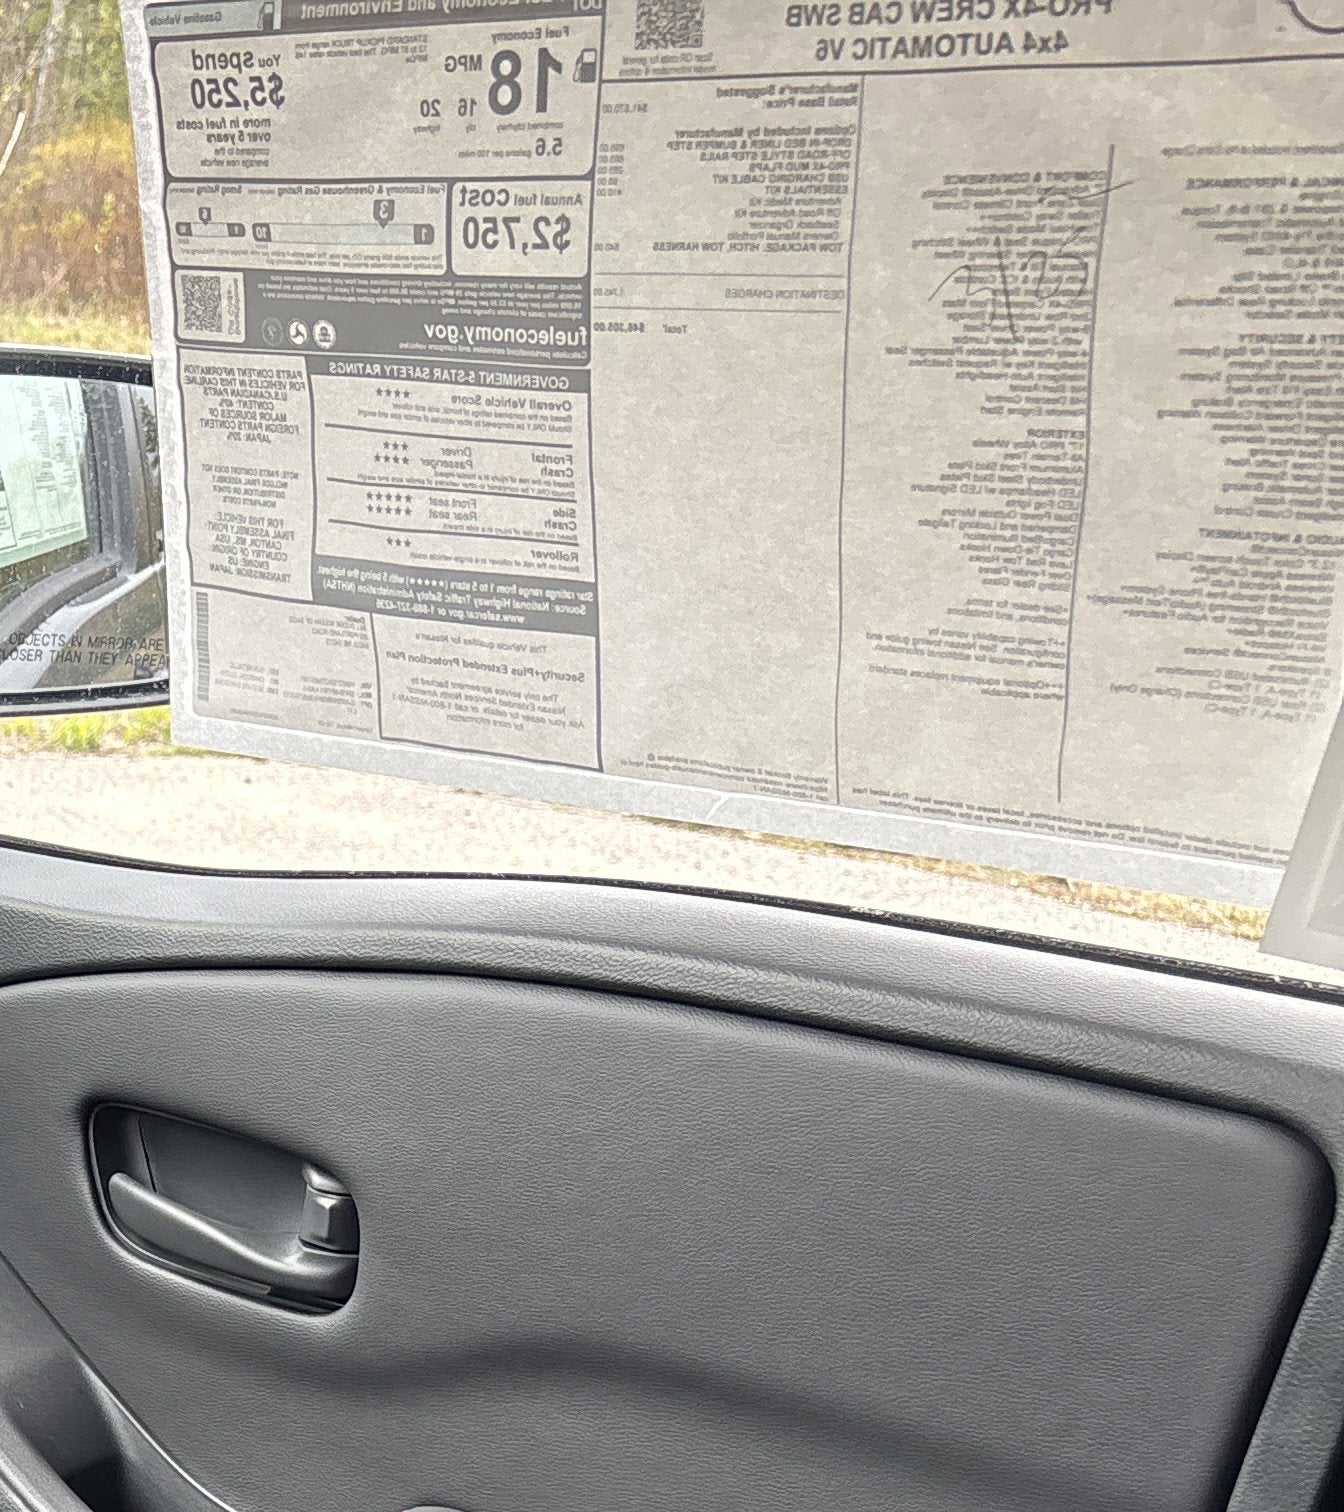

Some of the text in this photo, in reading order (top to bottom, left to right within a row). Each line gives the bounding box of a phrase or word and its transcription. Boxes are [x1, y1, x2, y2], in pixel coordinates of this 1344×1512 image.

[8, 632, 67, 647] OBJECTS
[87, 636, 134, 650] MIRROR
[139, 638, 165, 650] ARE
[50, 650, 81, 664] THAN
[88, 651, 119, 665] THEY
[124, 653, 170, 667] APPEA
